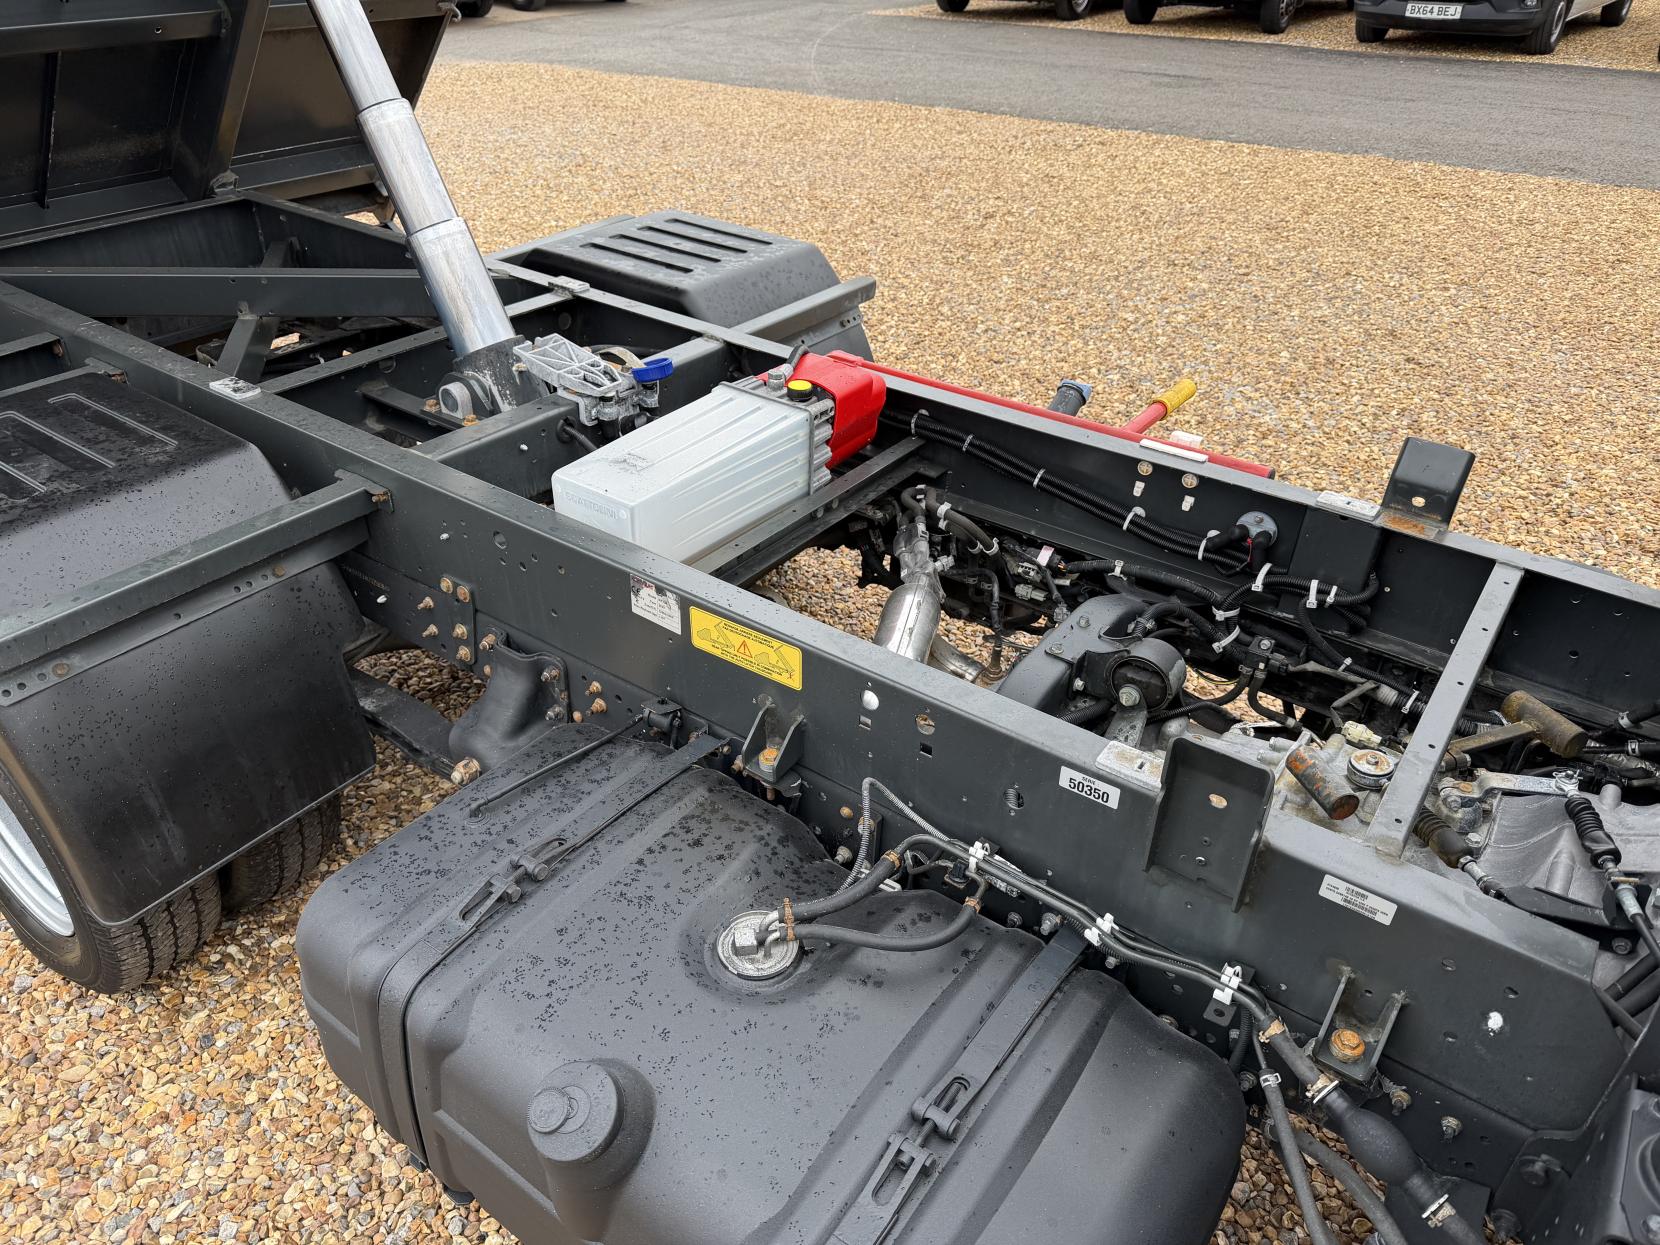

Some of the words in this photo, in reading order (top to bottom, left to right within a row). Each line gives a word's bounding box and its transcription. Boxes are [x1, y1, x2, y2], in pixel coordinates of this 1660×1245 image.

[1409, 5, 1434, 16] BX64
[1437, 6, 1458, 17] BEJ
[1068, 777, 1110, 804] 50350
